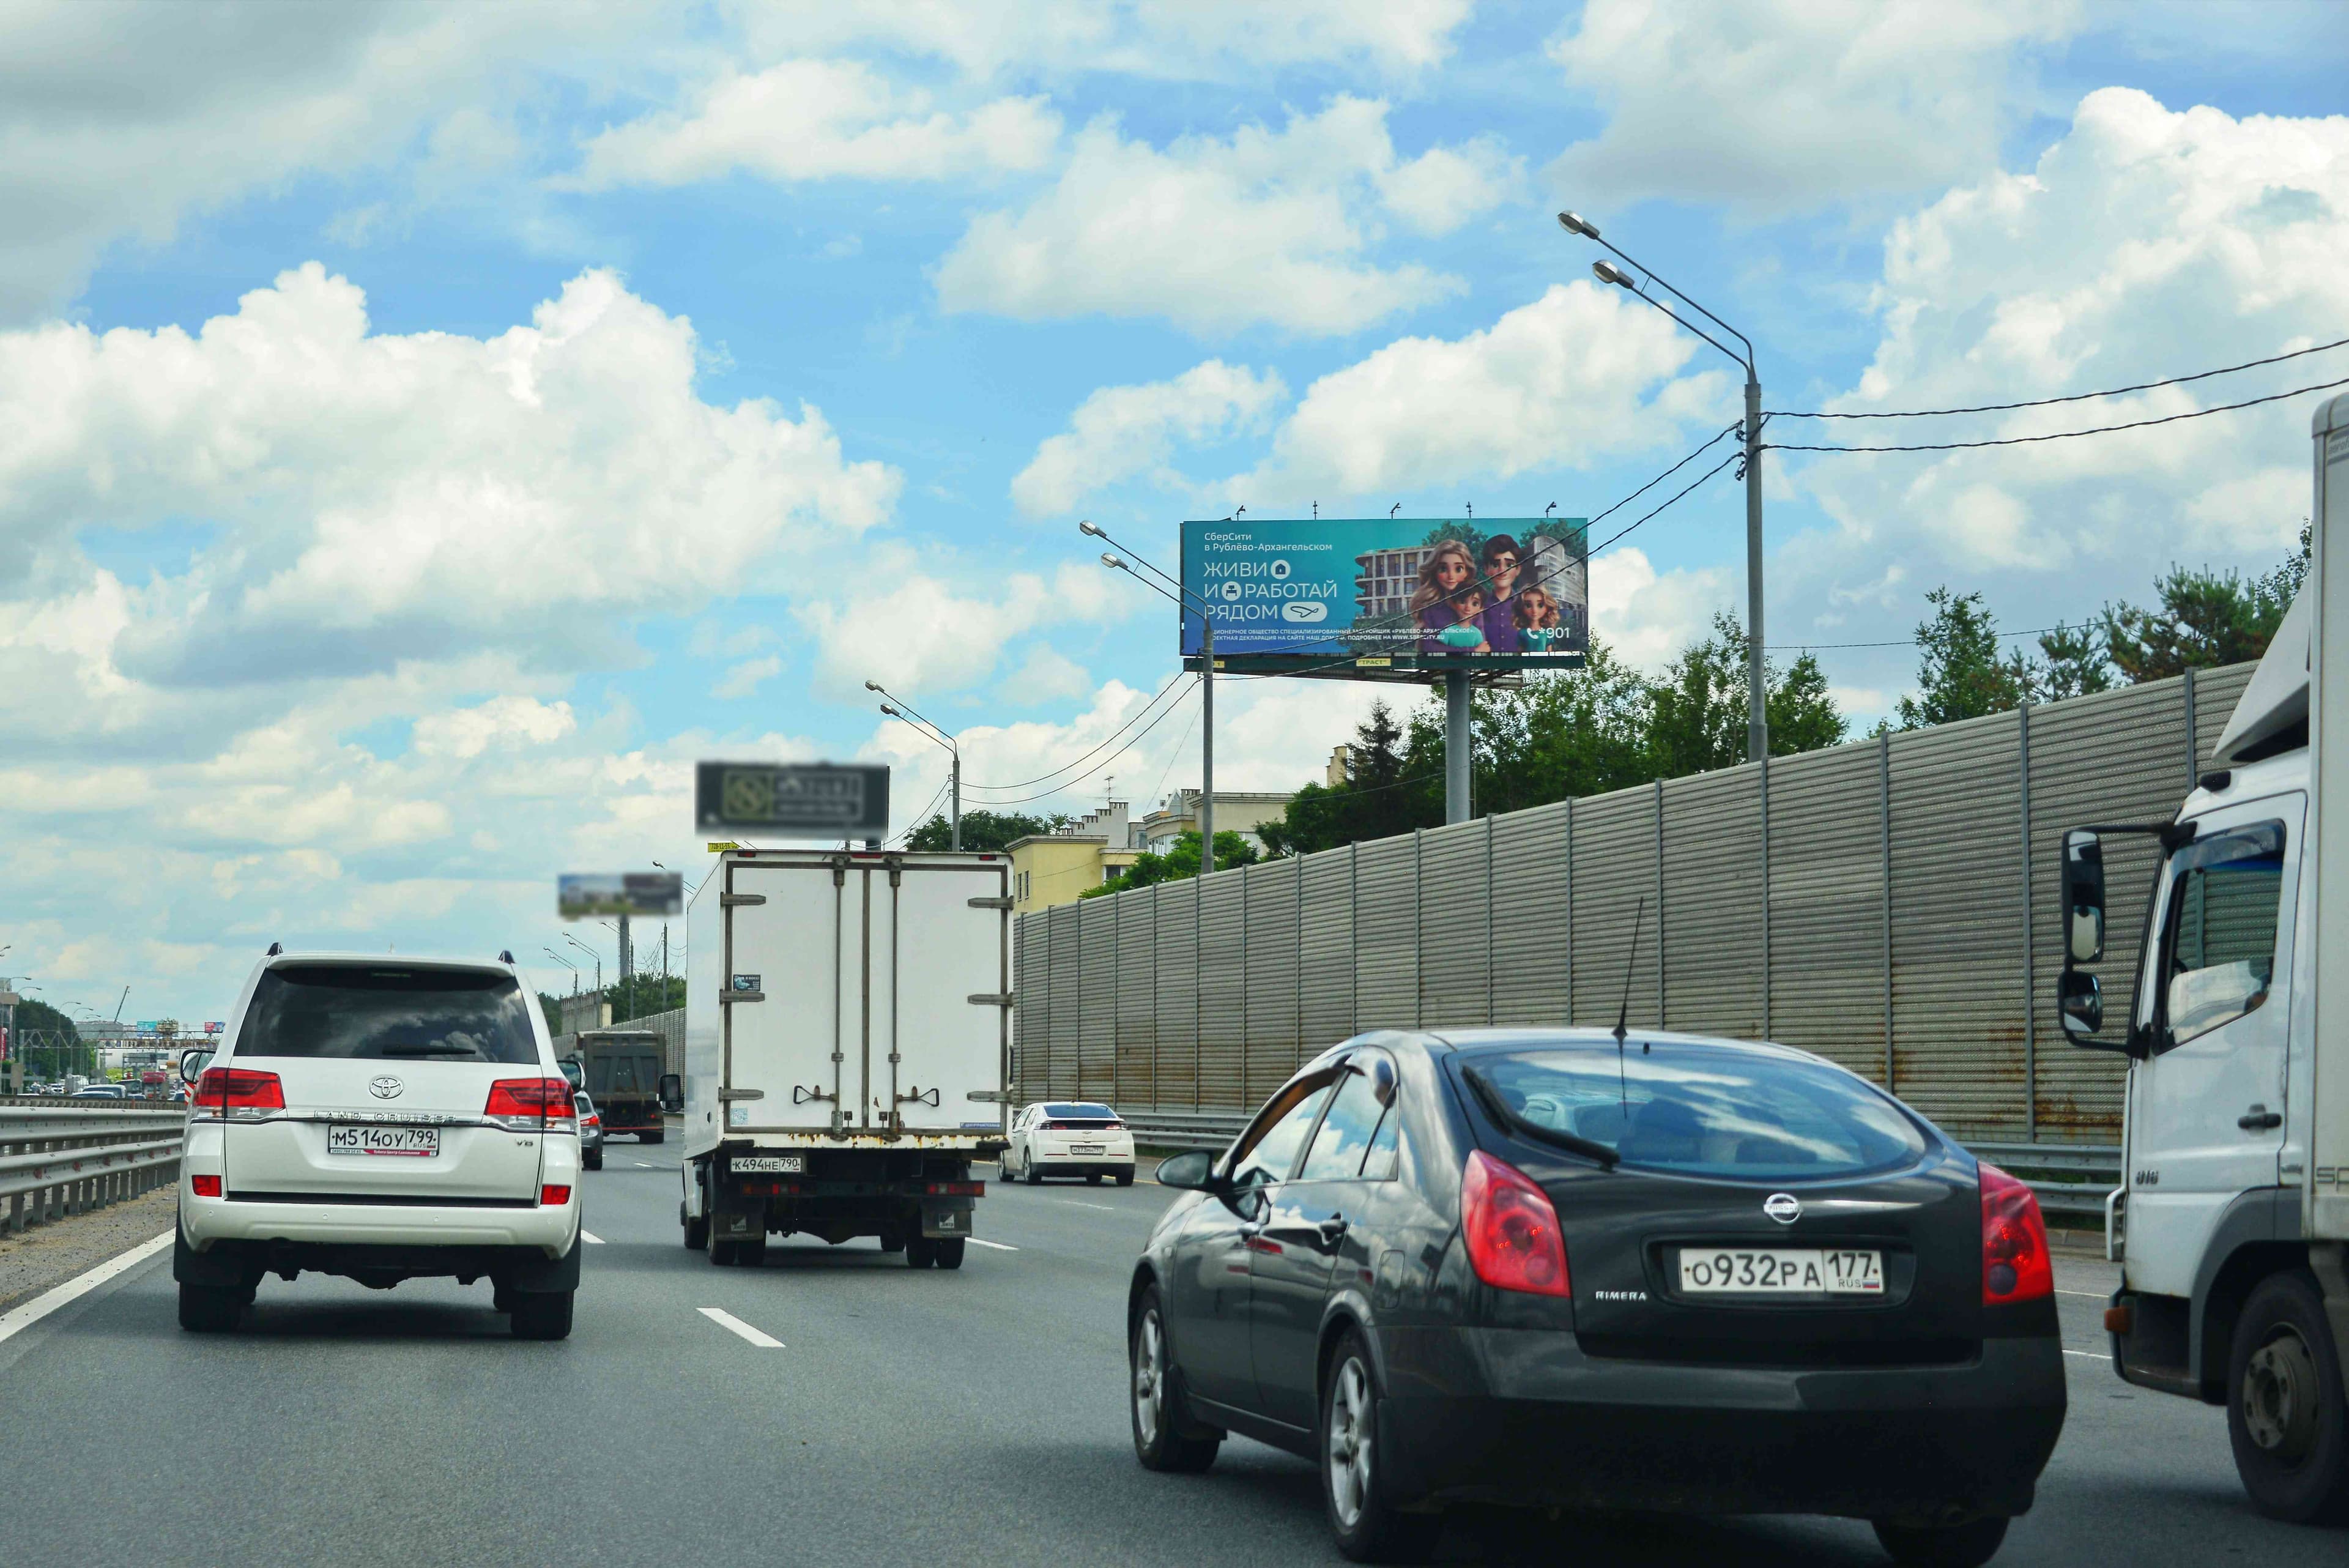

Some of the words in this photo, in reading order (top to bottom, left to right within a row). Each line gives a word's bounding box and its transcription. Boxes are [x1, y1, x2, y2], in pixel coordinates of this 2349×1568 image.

[1204, 533, 1252, 541] СберСити
[1213, 543, 1332, 552] Рублёво-Архангельском
[1203, 562, 1267, 577] ЖИВИ
[1204, 584, 1218, 598] И
[1245, 580, 1337, 598] РАБОТАЙ
[1204, 604, 1278, 622] РЯДОМ
[314, 1110, 361, 1120] LAND
[374, 1112, 456, 1124] CRUISER
[335, 1129, 404, 1146] М514ОУ
[408, 1130, 432, 1143] 799
[735, 1159, 779, 1170] К494НЕ
[781, 1159, 798, 1167] 790
[1692, 1253, 1821, 1287] О932РА
[1827, 1252, 1873, 1278] 177
[1838, 1279, 1861, 1288] RUS
